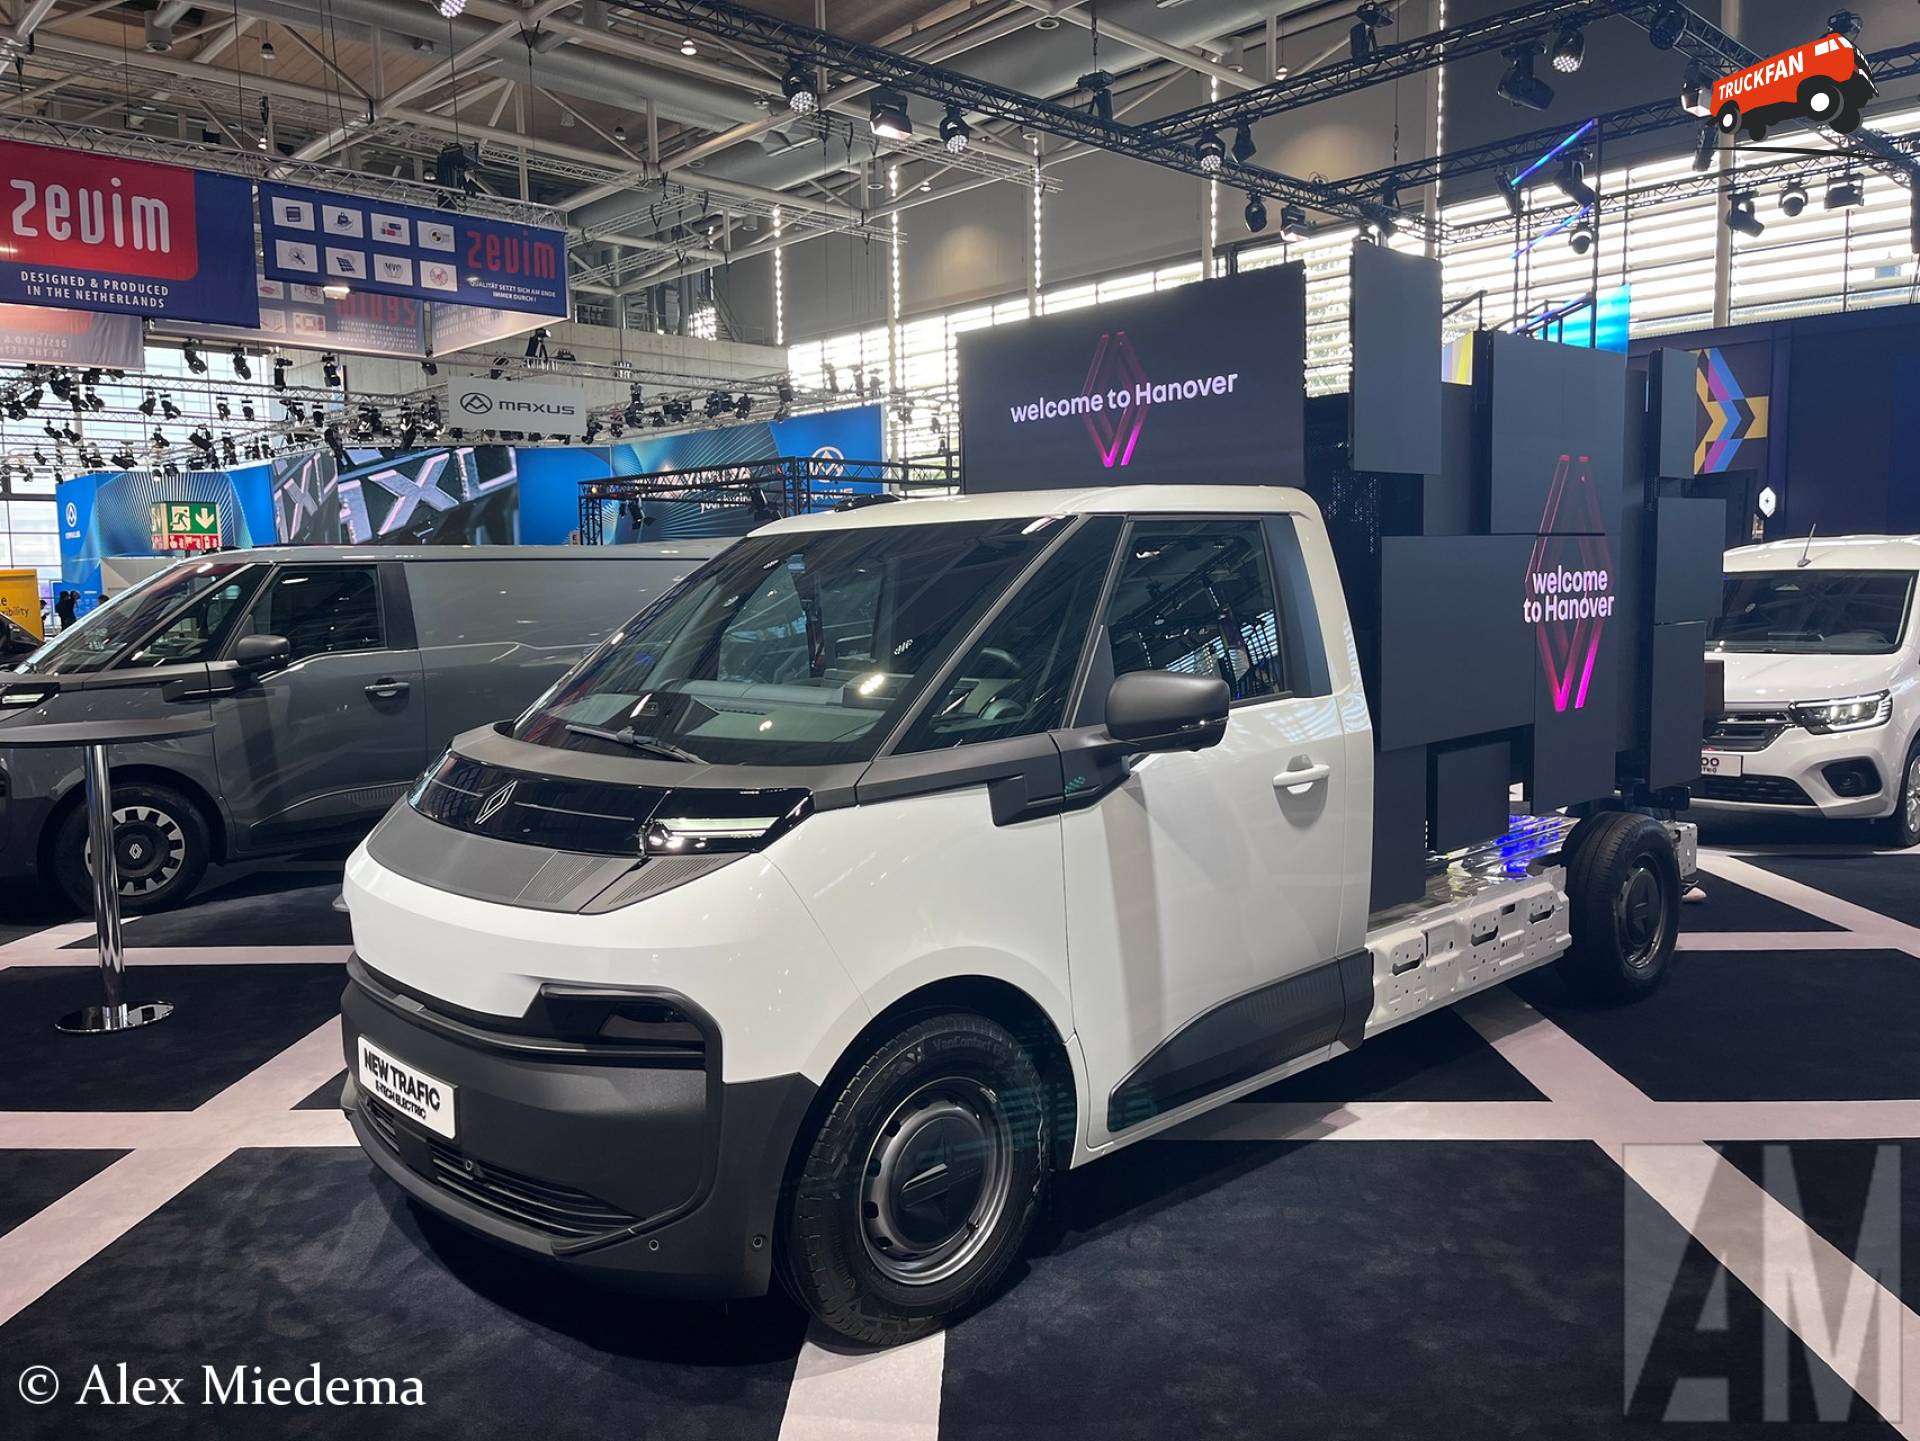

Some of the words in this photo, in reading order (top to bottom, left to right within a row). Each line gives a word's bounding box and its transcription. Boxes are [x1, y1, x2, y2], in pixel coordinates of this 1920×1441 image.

[20, 271, 85, 287] DESIGNED
[90, 278, 99, 289] &
[104, 280, 169, 296] PRODUCED
[27, 285, 41, 296] IN
[46, 286, 70, 299] THE
[75, 290, 165, 309] NETHERLANDS
[499, 401, 575, 415] MAXUS
[1010, 394, 1103, 423] welcome
[1106, 388, 1131, 409] to
[1135, 373, 1238, 406] Hanover
[1533, 565, 1608, 594] welcome
[1523, 598, 1542, 623] to
[1545, 595, 1615, 622] Hanover
[363, 1047, 389, 1084] NEW
[390, 1065, 440, 1112] TRAFIC
[375, 1079, 395, 1102] E-TECH
[395, 1092, 427, 1120] ELECTRIC
